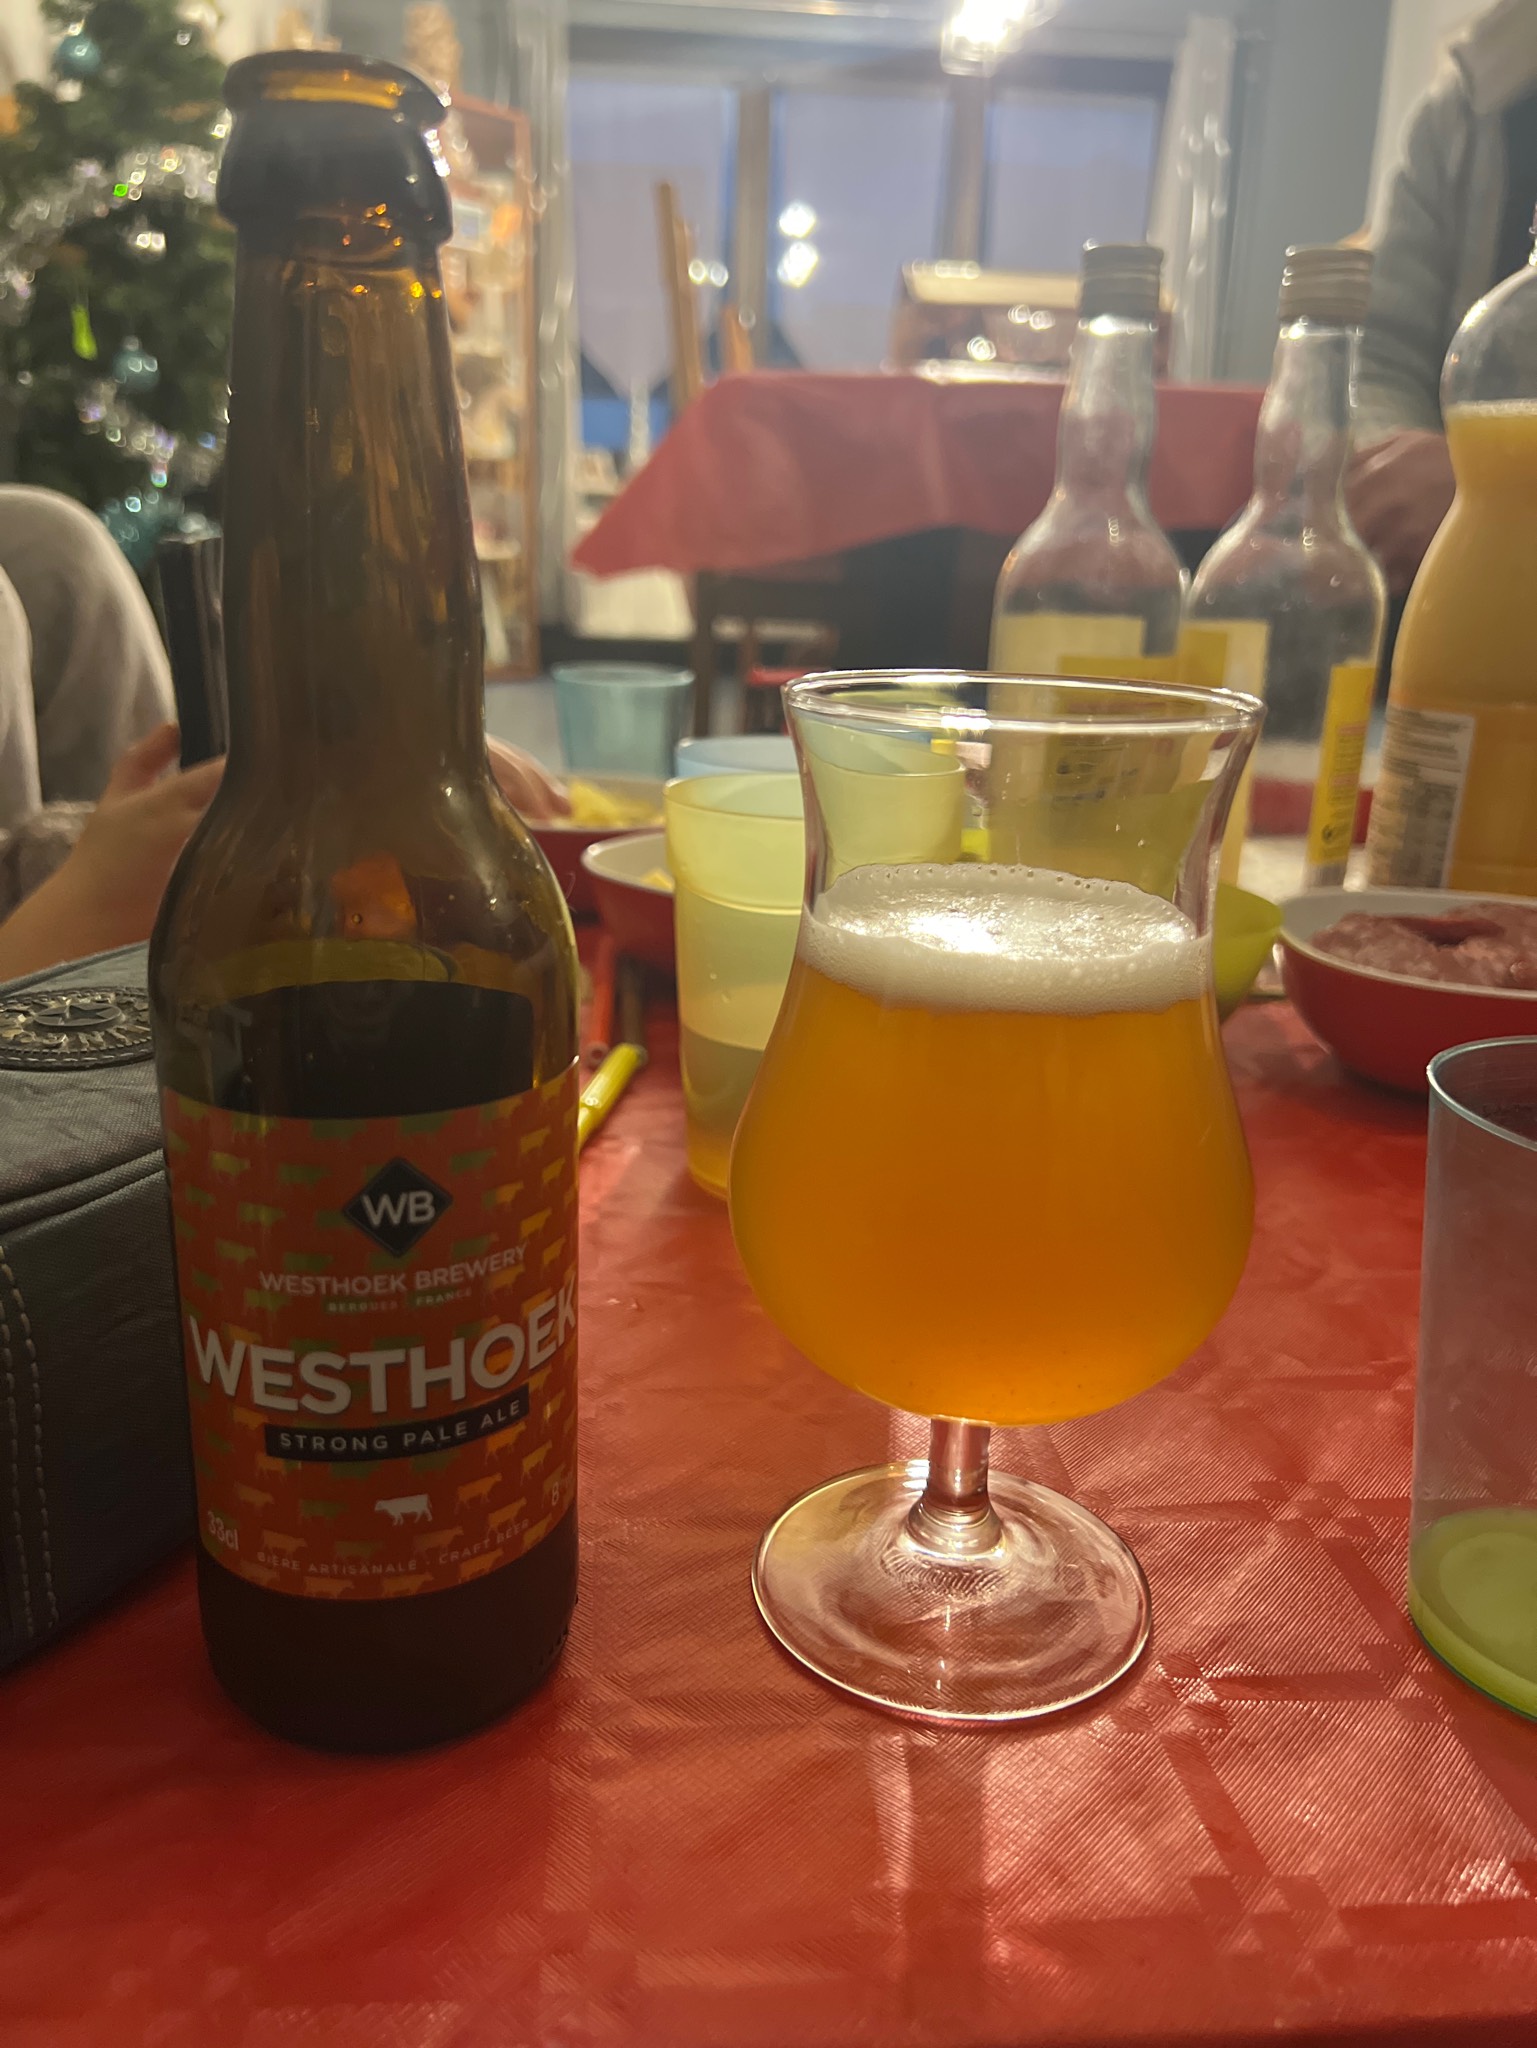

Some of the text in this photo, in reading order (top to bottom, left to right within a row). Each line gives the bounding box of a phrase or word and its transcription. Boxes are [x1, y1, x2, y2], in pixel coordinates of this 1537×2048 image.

[361, 1189, 435, 1227] WB
[259, 1242, 528, 1297] WESTHOEK BREWERY
[416, 1287, 473, 1306] FRANCE
[189, 1270, 577, 1415] WESTHOEK
[280, 1399, 522, 1453] STRONG PALE ALE
[207, 1510, 239, 1551] 33cl
[308, 1559, 417, 1575] ARTISANALE
[438, 1539, 490, 1564] CRAFT
[496, 1518, 529, 1544] BEER
